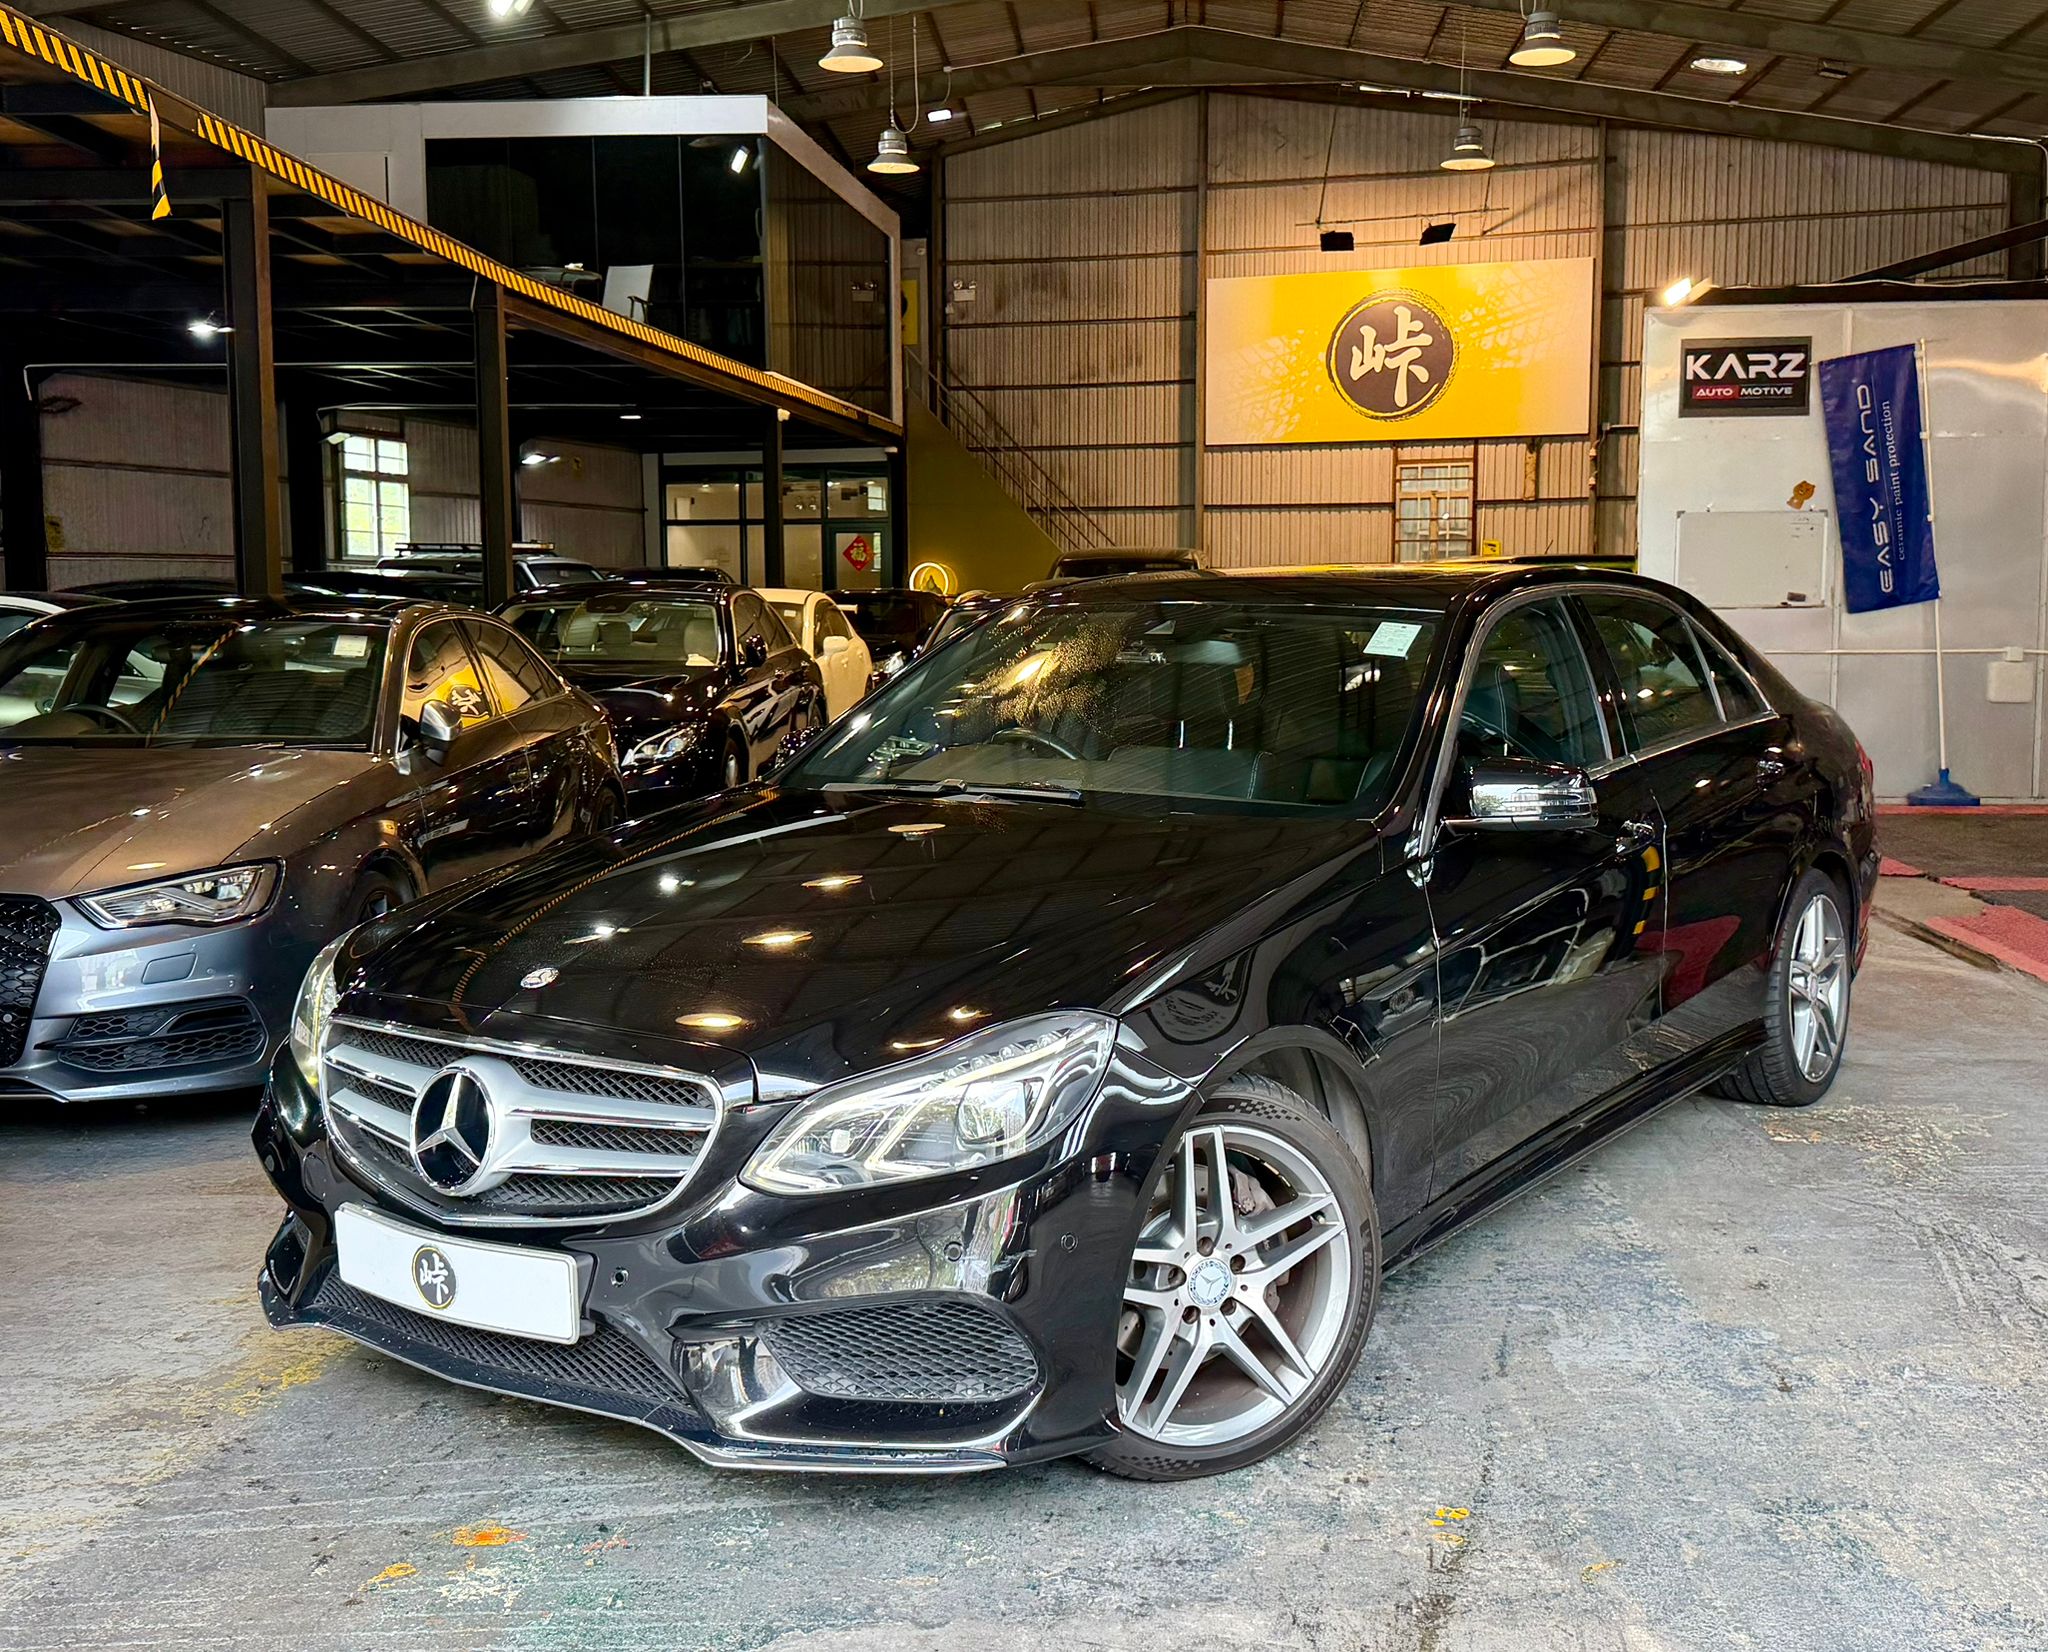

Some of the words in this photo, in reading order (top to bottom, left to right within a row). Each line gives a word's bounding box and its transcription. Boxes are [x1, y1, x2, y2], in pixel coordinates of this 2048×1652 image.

[1350, 306, 1433, 408] 峠
[1686, 352, 1805, 380] KARZ
[1695, 387, 1734, 397] AUTO
[1739, 386, 1794, 396] MOTIVE
[1857, 384, 1879, 483] SAND
[1881, 400, 1901, 467] protection
[1890, 471, 1904, 505] paint
[1869, 497, 1893, 593] EASY
[1895, 509, 1905, 561] ceramic
[420, 1252, 450, 1304] 峠
